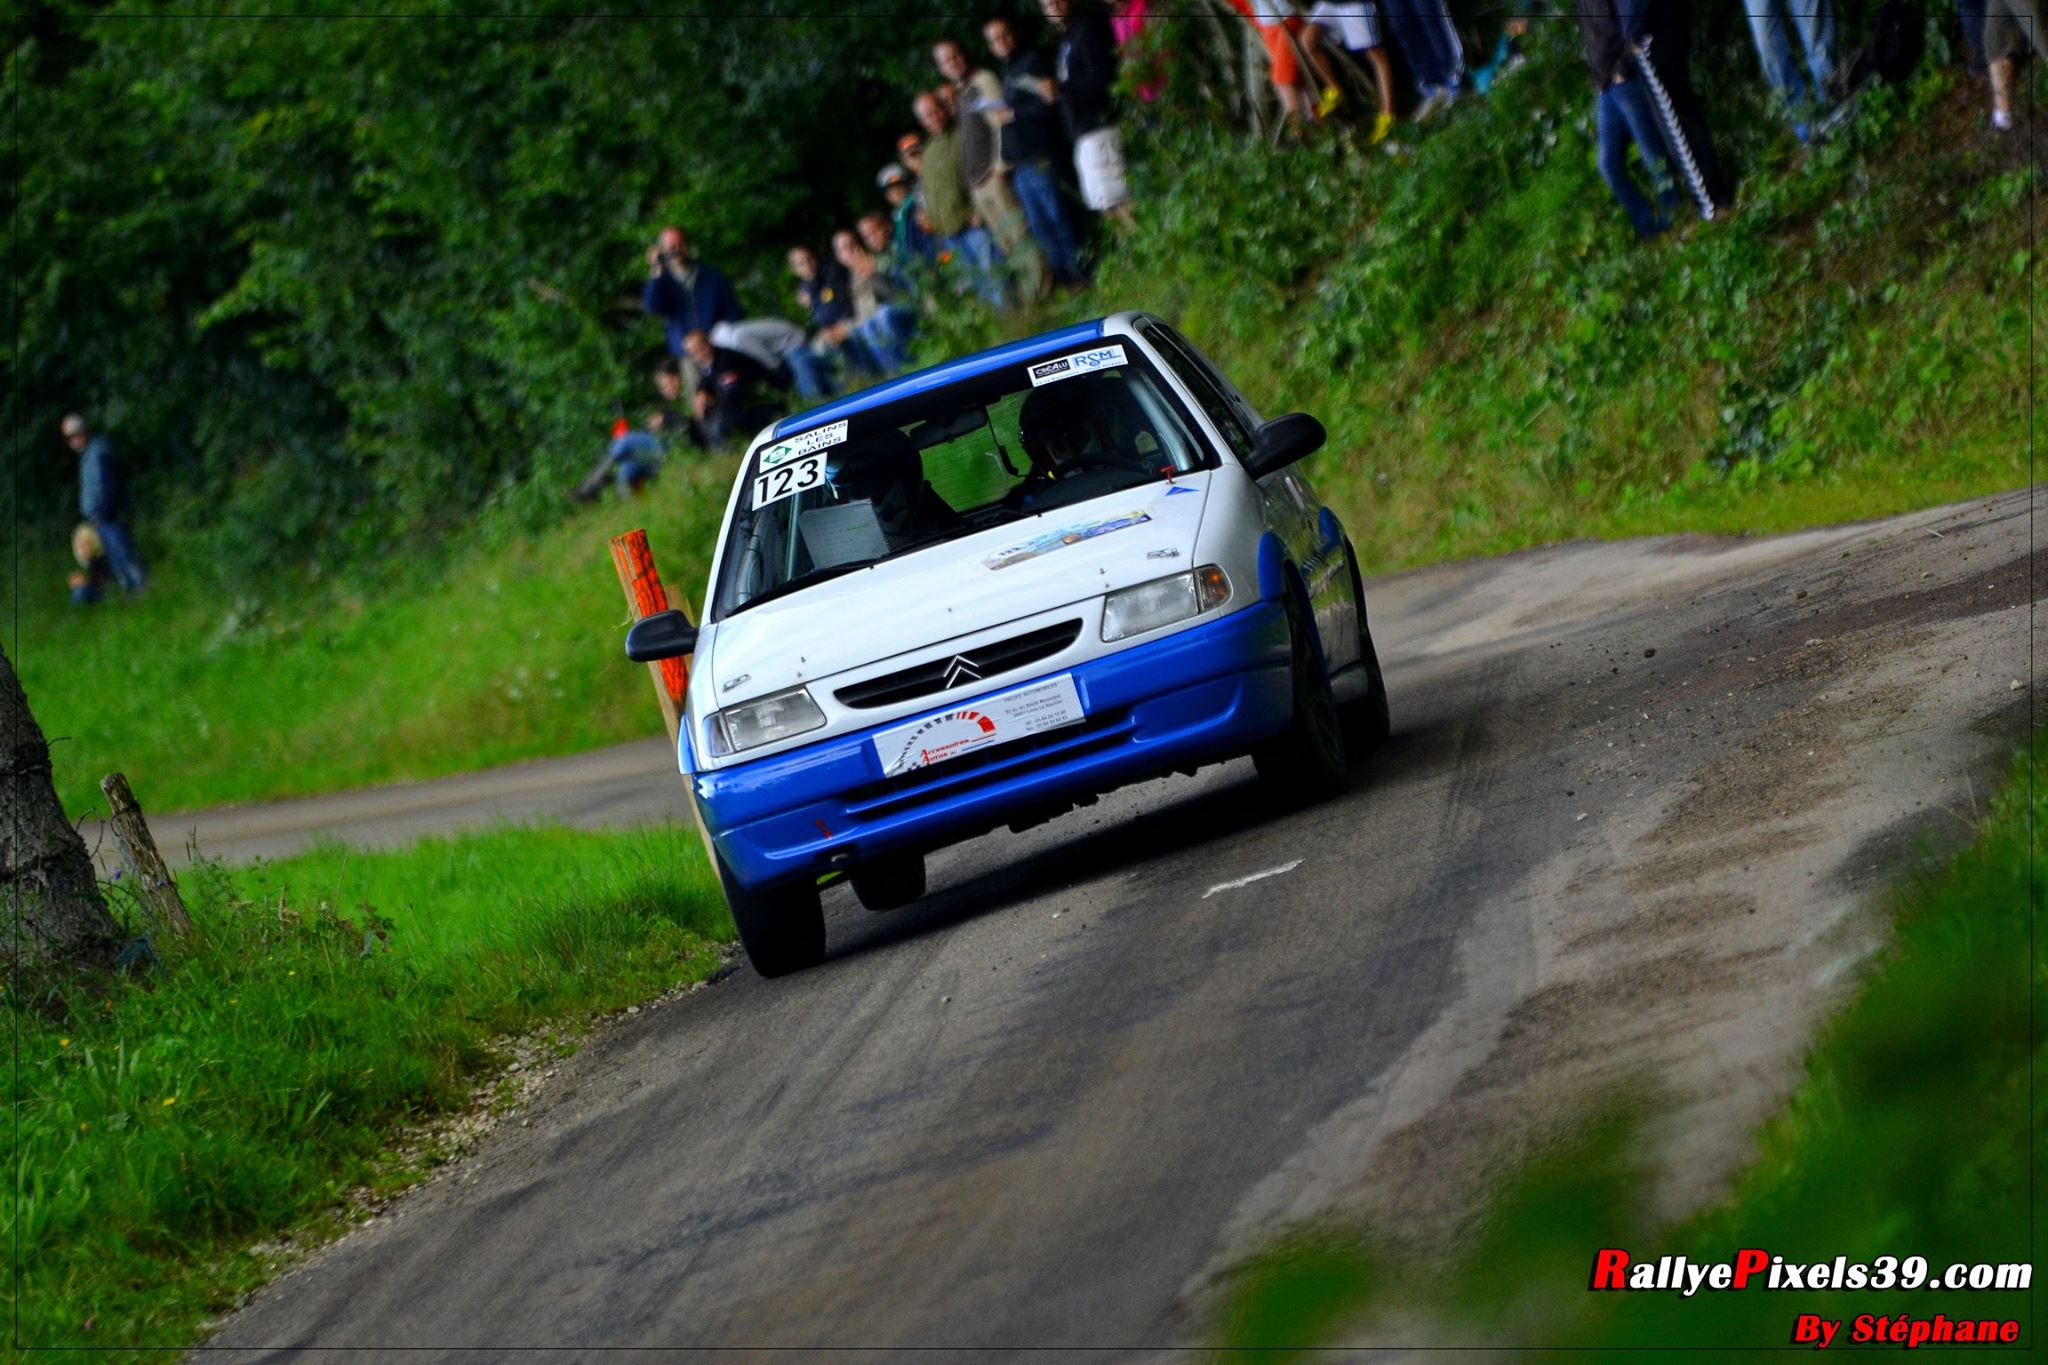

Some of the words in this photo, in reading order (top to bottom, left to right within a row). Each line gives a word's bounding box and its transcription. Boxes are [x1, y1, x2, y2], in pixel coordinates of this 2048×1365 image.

[794, 422, 847, 443] SALINS
[806, 432, 834, 446] LES
[797, 436, 842, 456] BAINS
[758, 459, 819, 503] 123
[921, 738, 970, 757] Accessoires
